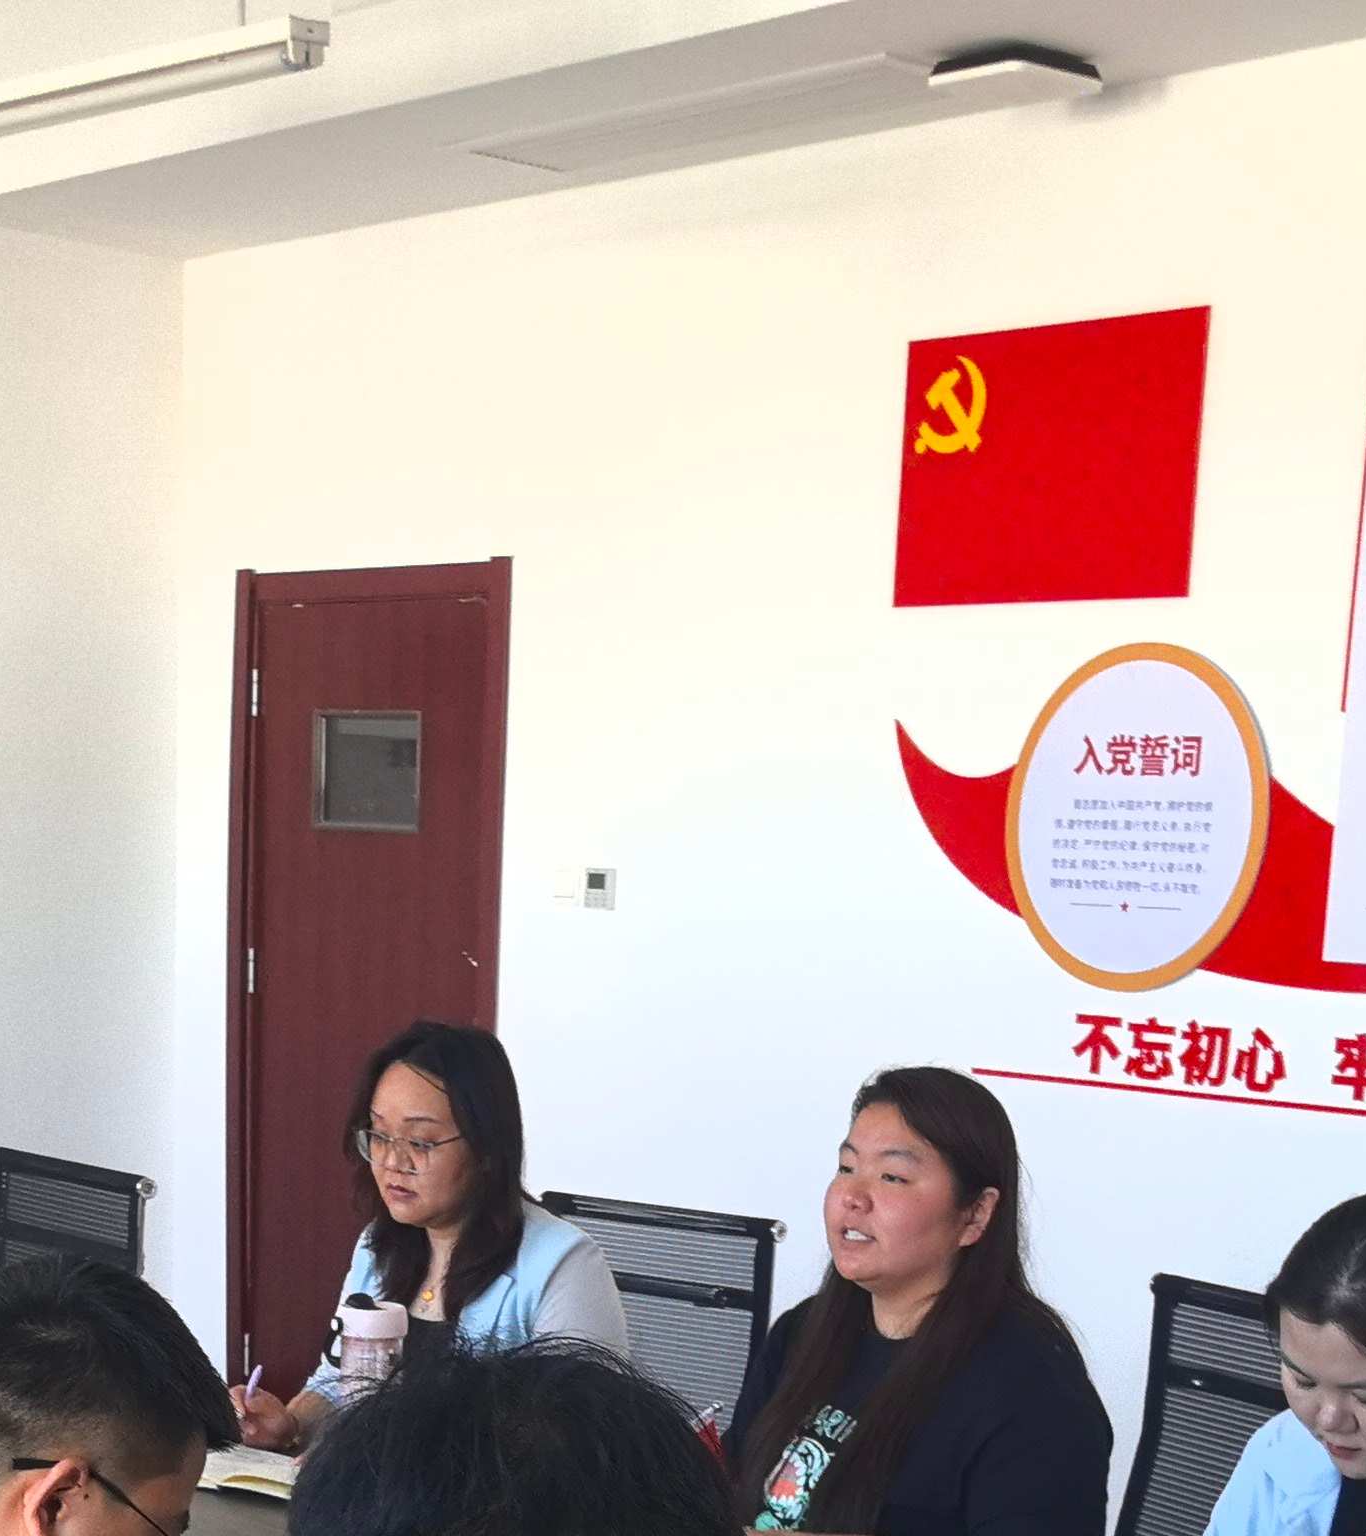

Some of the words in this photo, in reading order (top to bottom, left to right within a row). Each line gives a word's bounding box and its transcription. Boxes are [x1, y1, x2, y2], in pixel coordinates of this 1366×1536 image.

[1073, 734, 1203, 777] 入党誓词
[1072, 1013, 1287, 1093] 不忘初心
